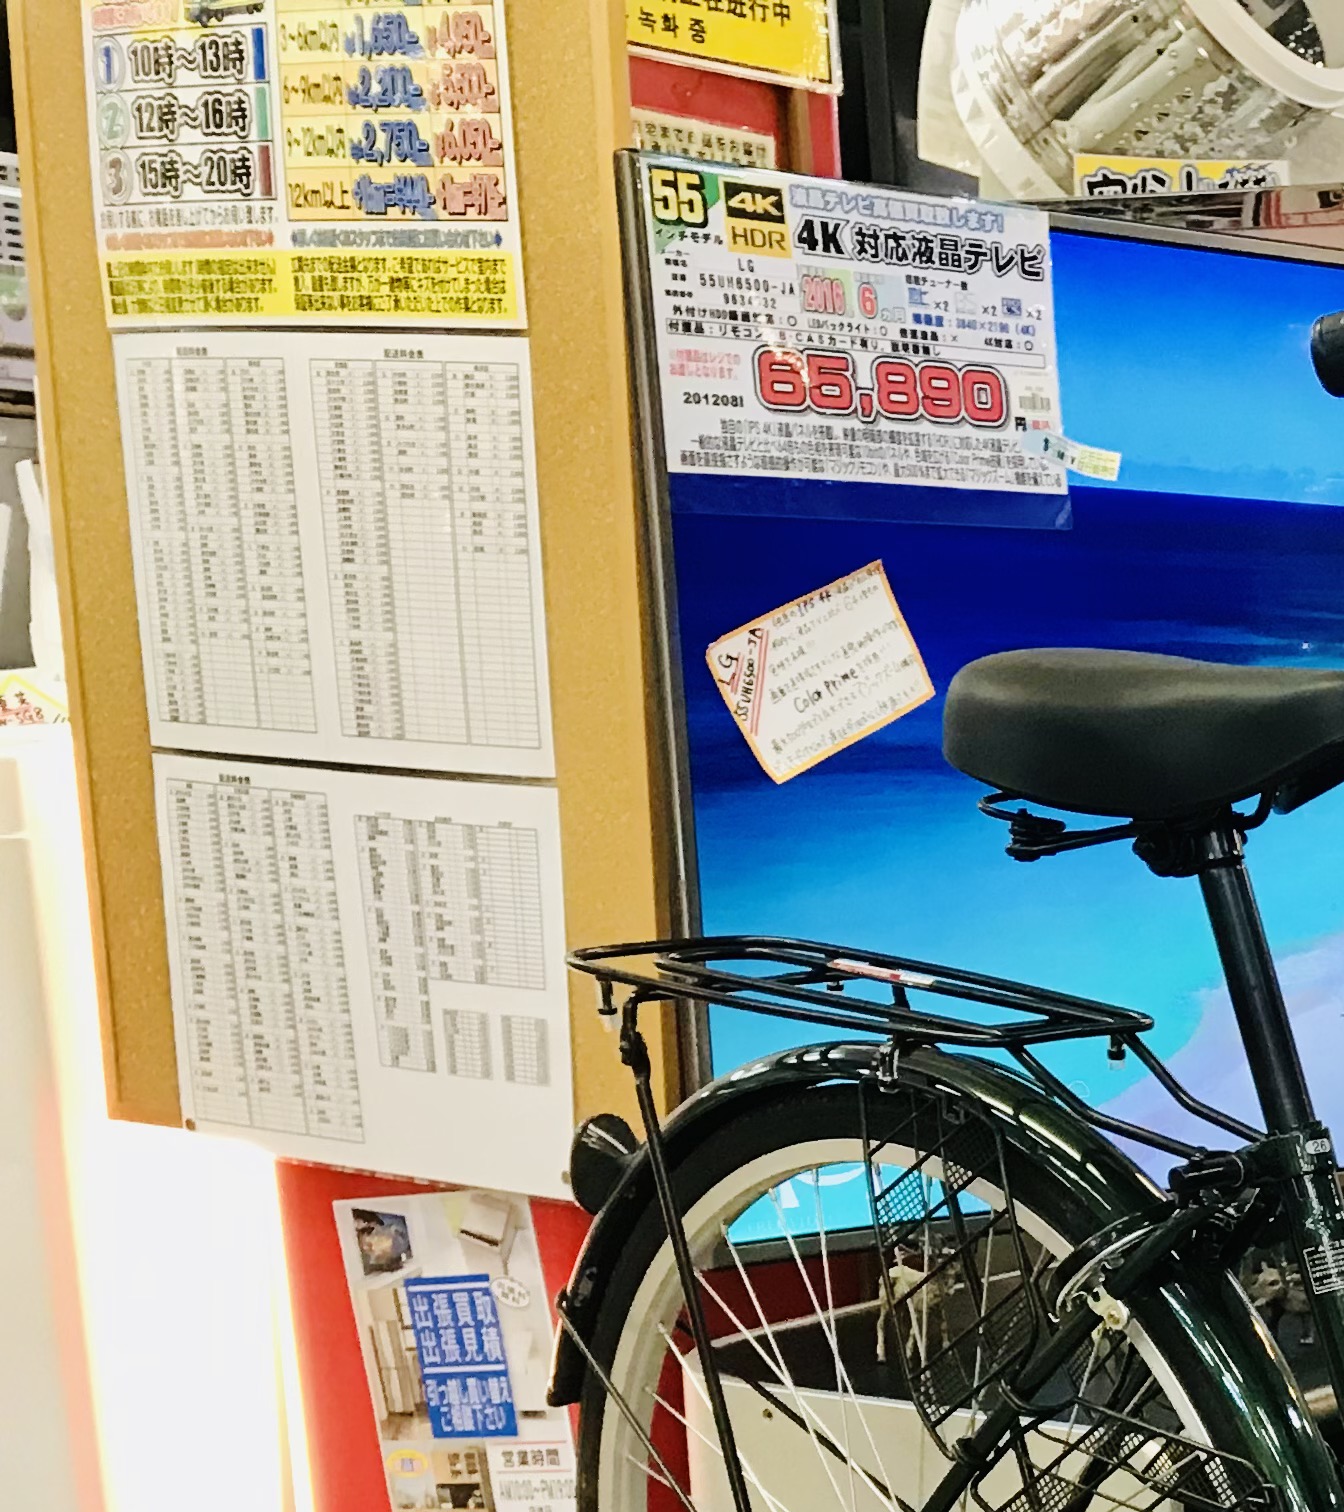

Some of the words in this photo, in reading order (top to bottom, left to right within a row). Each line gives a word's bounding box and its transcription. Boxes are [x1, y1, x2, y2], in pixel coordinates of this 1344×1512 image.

[638, 6, 679, 38] 녹화
[689, 17, 706, 44] 중
[650, 168, 706, 227] 55
[727, 191, 783, 217] 4K
[731, 225, 786, 251] HDR
[797, 217, 846, 256] 4K
[856, 227, 1043, 279] 対応液晶テレビ
[737, 257, 756, 273] LG
[858, 282, 877, 319] 6
[755, 345, 1007, 425] 65,890
[1312, 1140, 1328, 1152] 26
[412, 1291, 497, 1328] 出張買取
[420, 1326, 504, 1365] 出張見積
